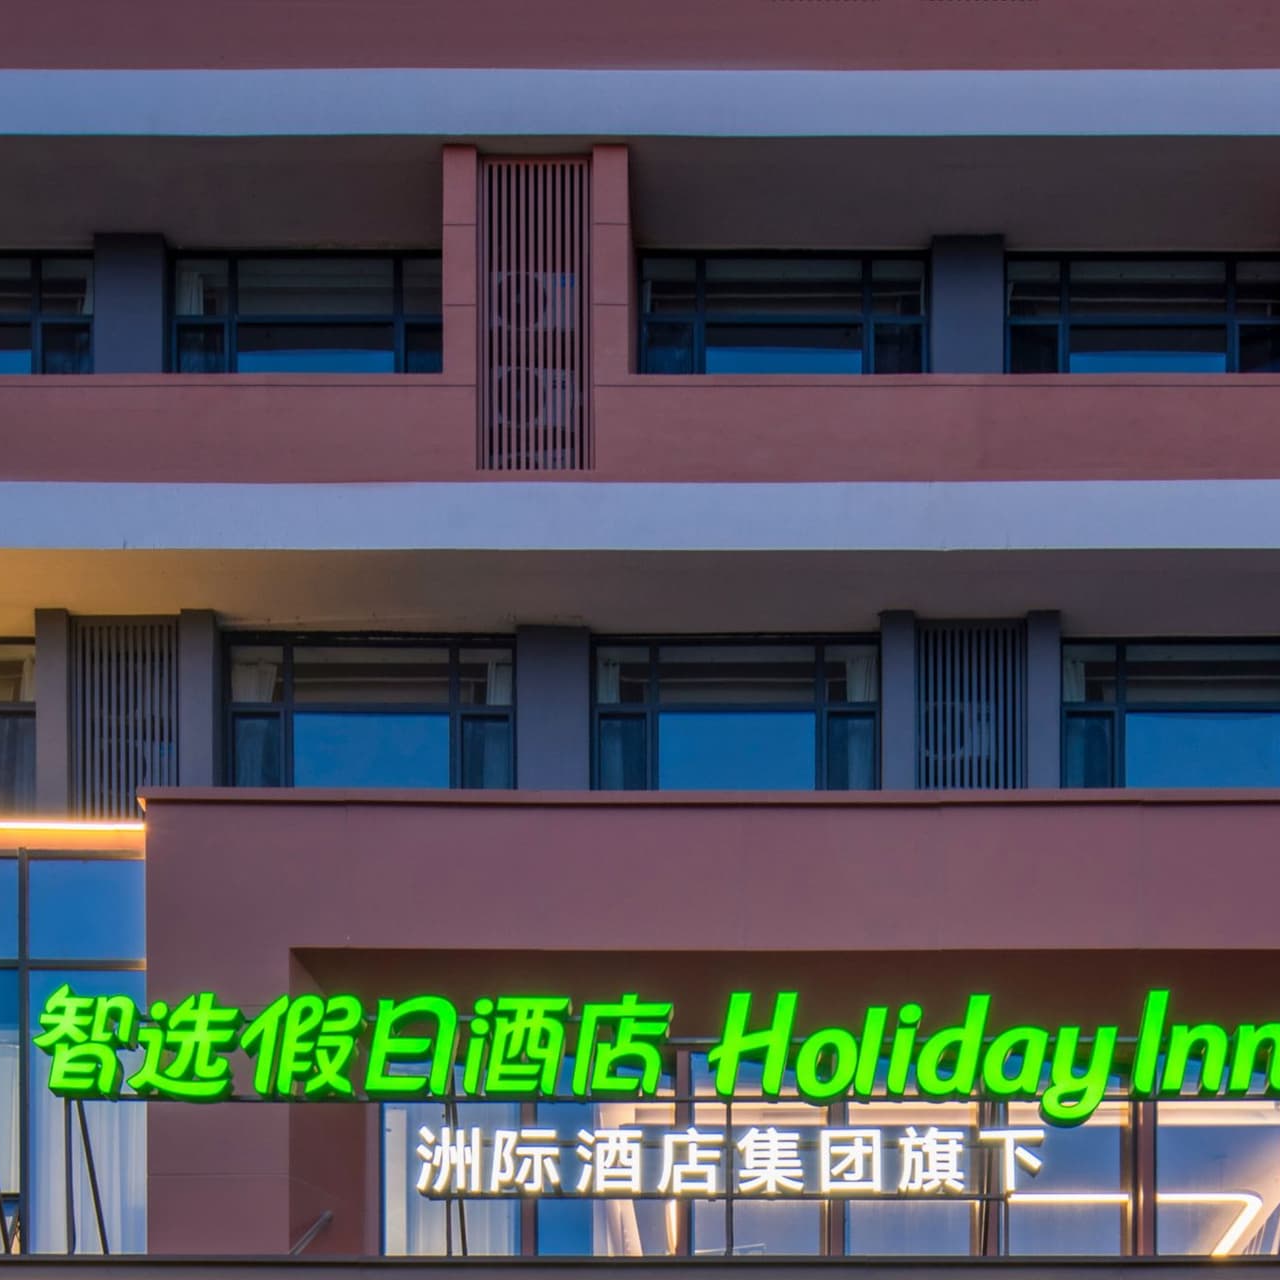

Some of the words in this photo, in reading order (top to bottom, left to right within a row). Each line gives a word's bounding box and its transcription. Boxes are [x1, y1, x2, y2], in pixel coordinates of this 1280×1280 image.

[31, 982, 675, 1099] 智选假日酒店
[708, 992, 1119, 1125] Holiday
[415, 1126, 1047, 1194] 洲际酒店集团旗下
